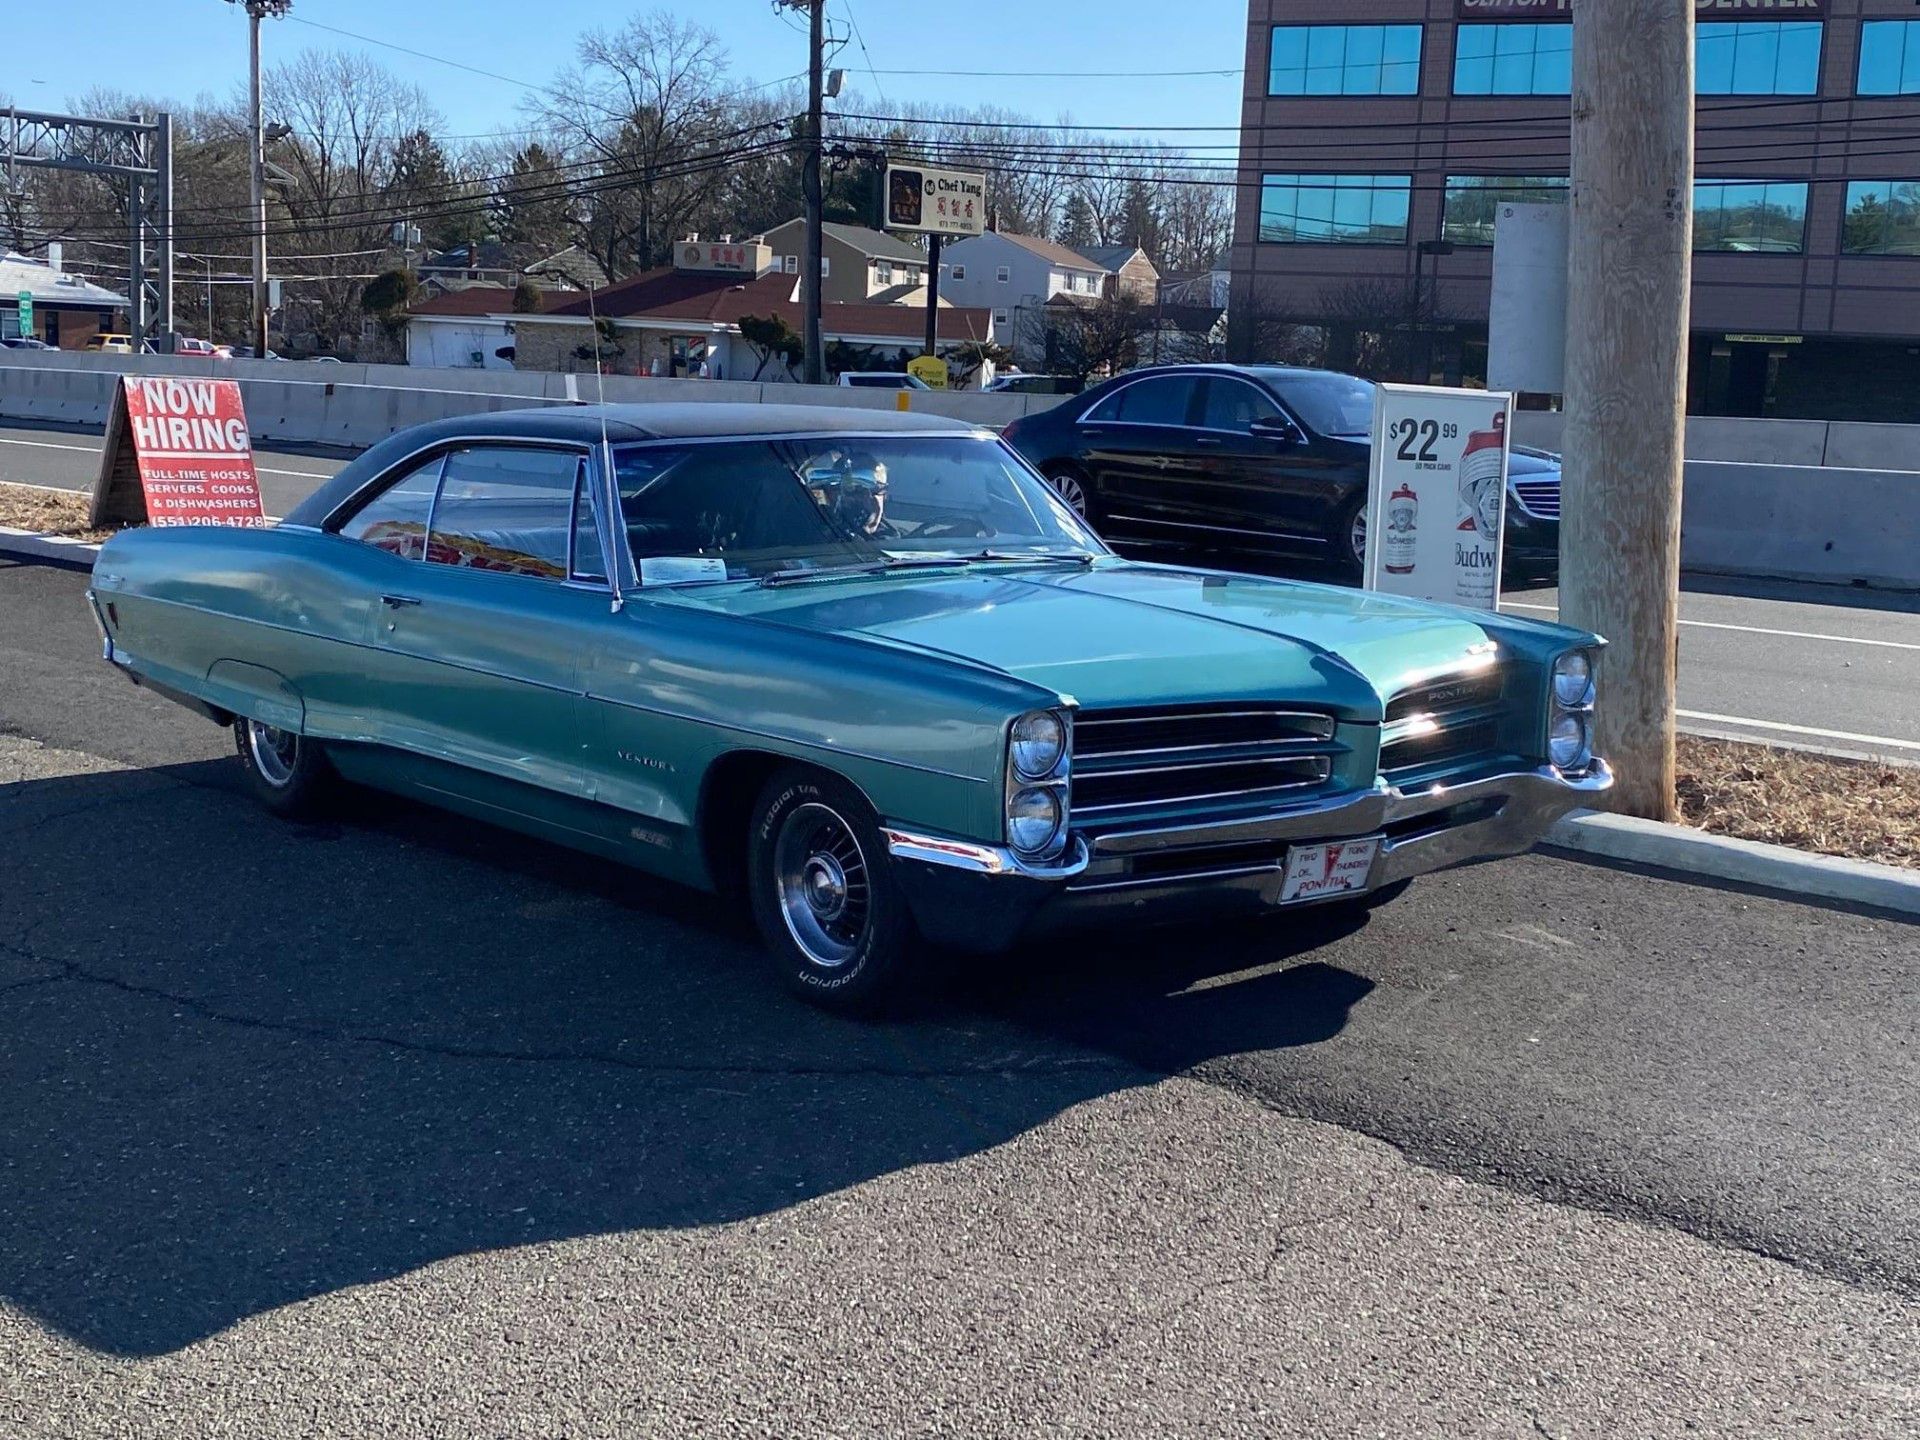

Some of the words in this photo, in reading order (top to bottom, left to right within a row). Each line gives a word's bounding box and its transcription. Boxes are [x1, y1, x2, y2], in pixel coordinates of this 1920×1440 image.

[938, 178, 958, 192] Chef
[961, 180, 982, 197] Yang
[142, 381, 216, 415] NOW
[134, 415, 249, 451] HIRING
[144, 469, 208, 479] FULL-TIME
[153, 499, 162, 508] &
[166, 499, 257, 508] DISHWASHERS
[1299, 874, 1353, 892] PONTIAC
